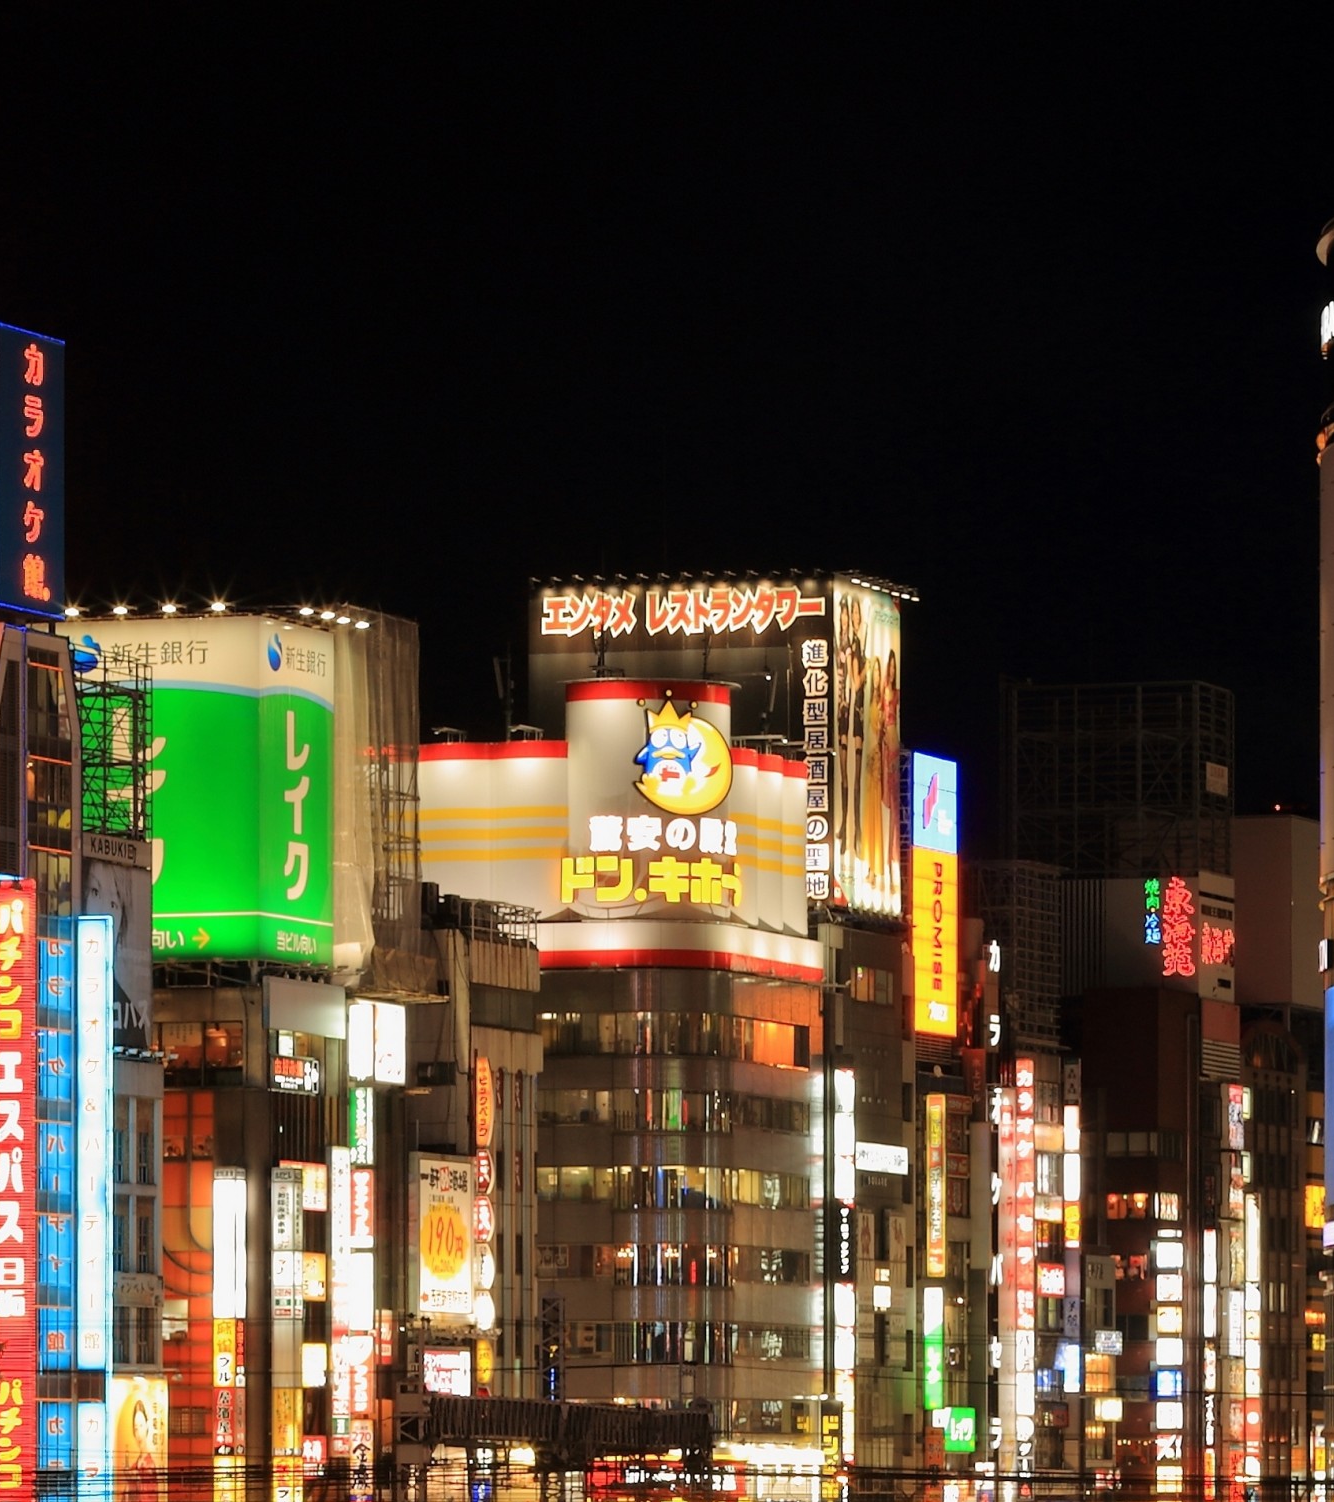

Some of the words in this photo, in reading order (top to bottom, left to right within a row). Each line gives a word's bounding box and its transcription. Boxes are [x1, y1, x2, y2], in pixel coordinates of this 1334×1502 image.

[110, 639, 209, 667] 新生銀行
[541, 590, 637, 637] エンタメ
[645, 586, 825, 635] レストランタワー
[285, 645, 327, 677] 新生銀行
[283, 709, 311, 901] レイク
[801, 639, 830, 900] 進化型居酒屋の聖地
[932, 861, 944, 992] PROMISE
